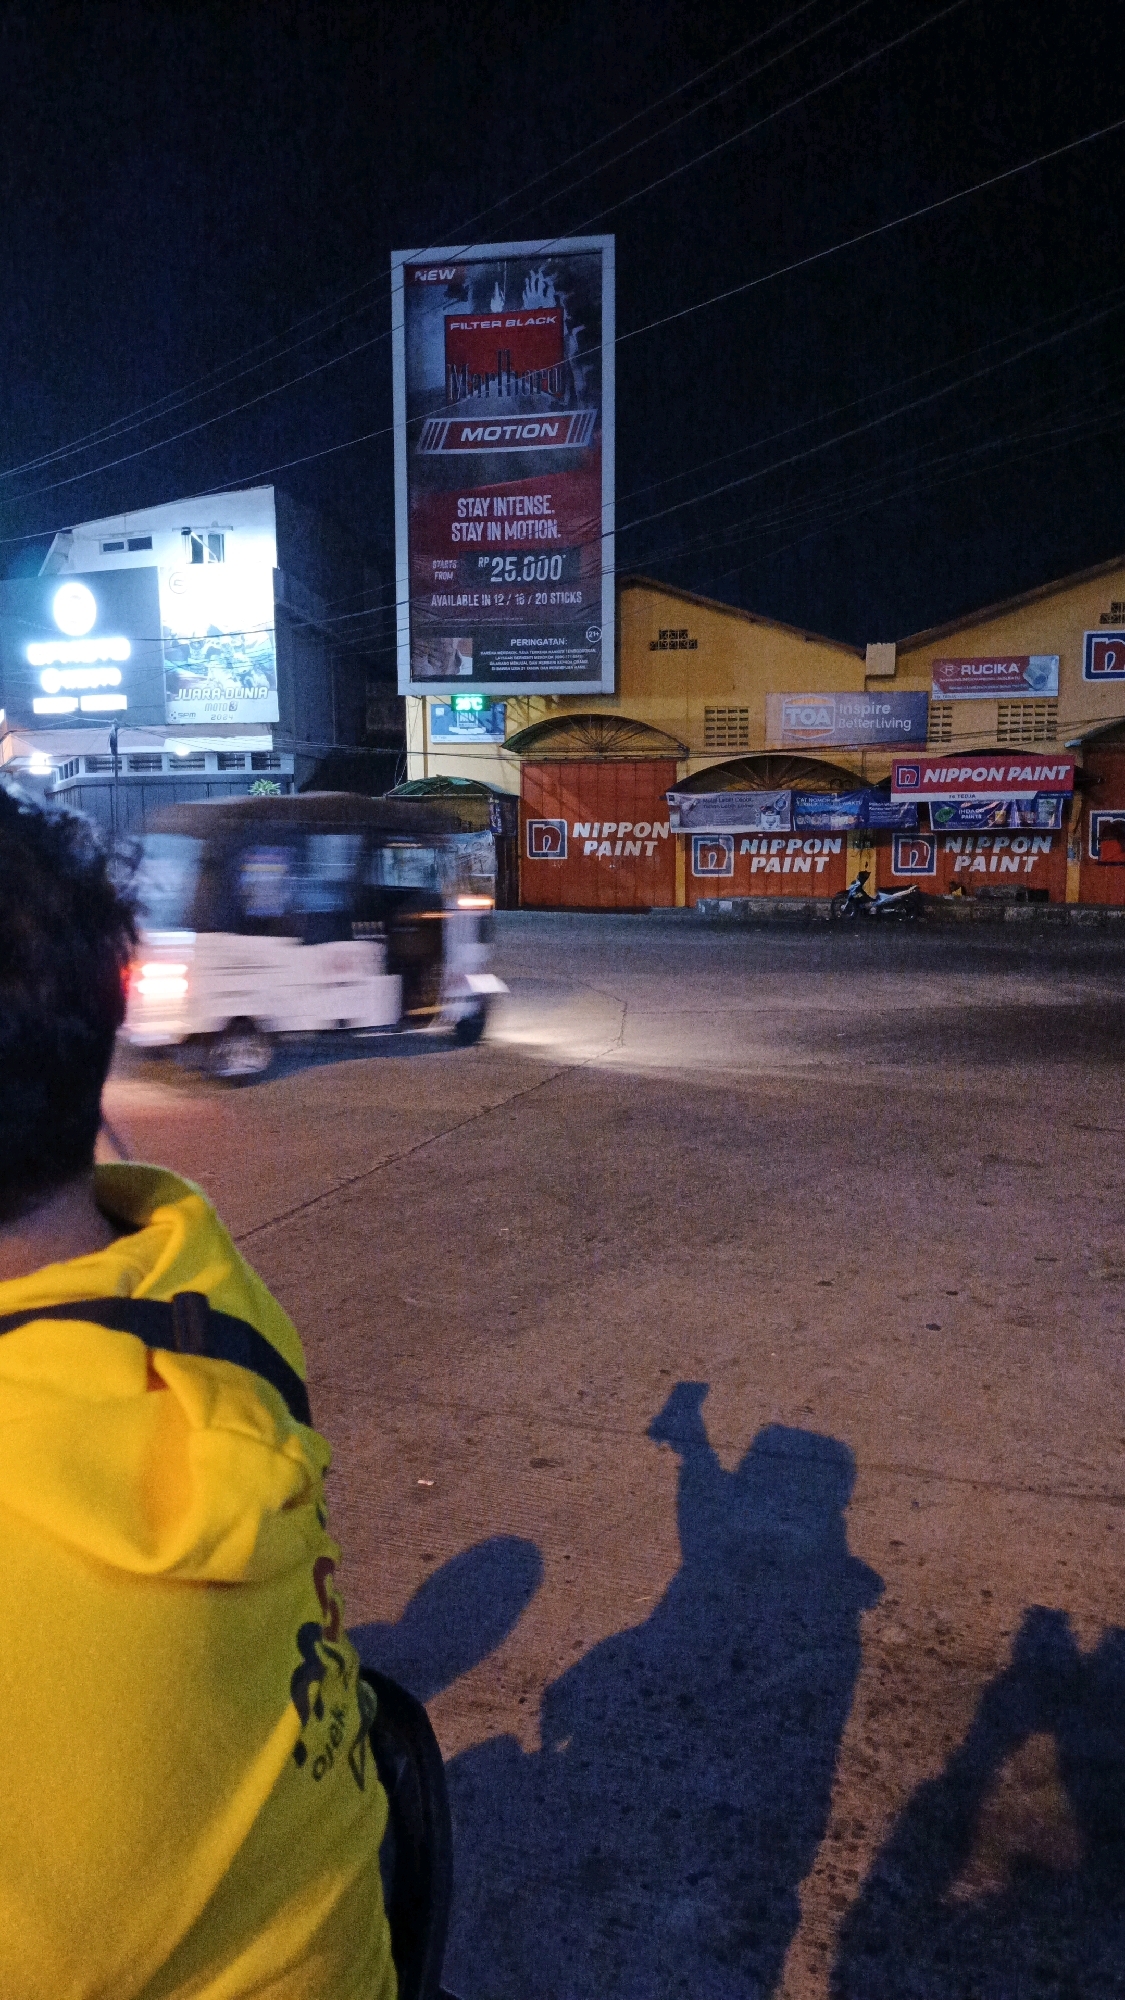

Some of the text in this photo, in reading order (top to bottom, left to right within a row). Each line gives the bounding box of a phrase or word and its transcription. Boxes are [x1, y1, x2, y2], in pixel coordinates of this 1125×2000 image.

[414, 268, 456, 282] NEW
[450, 315, 557, 330] FILTER BLACK
[461, 422, 560, 443] MOTION
[457, 494, 555, 519] STAY INTENSE.
[451, 519, 561, 542] STAY IN MOTION.
[478, 556, 490, 568] RP
[434, 570, 453, 581] FROM
[431, 594, 480, 607] AVAILABLE
[481, 593, 491, 606] IN
[494, 593, 505, 606] 12
[535, 592, 548, 605] 20
[550, 591, 582, 604] STICKS
[510, 637, 568, 646] PERINGATAN:
[960, 663, 1020, 675] RUCIKA
[175, 687, 269, 702] JUARA DUNIA
[785, 702, 892, 726] TOA Inspire
[838, 717, 912, 732] Better Living
[923, 767, 1005, 782] NIPPON
[1007, 765, 1070, 781] PAINT
[572, 821, 670, 840] NIPPON
[583, 841, 658, 858] PAINT
[739, 838, 843, 855] NIPPON
[944, 835, 1053, 855] NIPPON
[750, 856, 830, 873] PAINT
[954, 855, 1039, 873] PAINT
